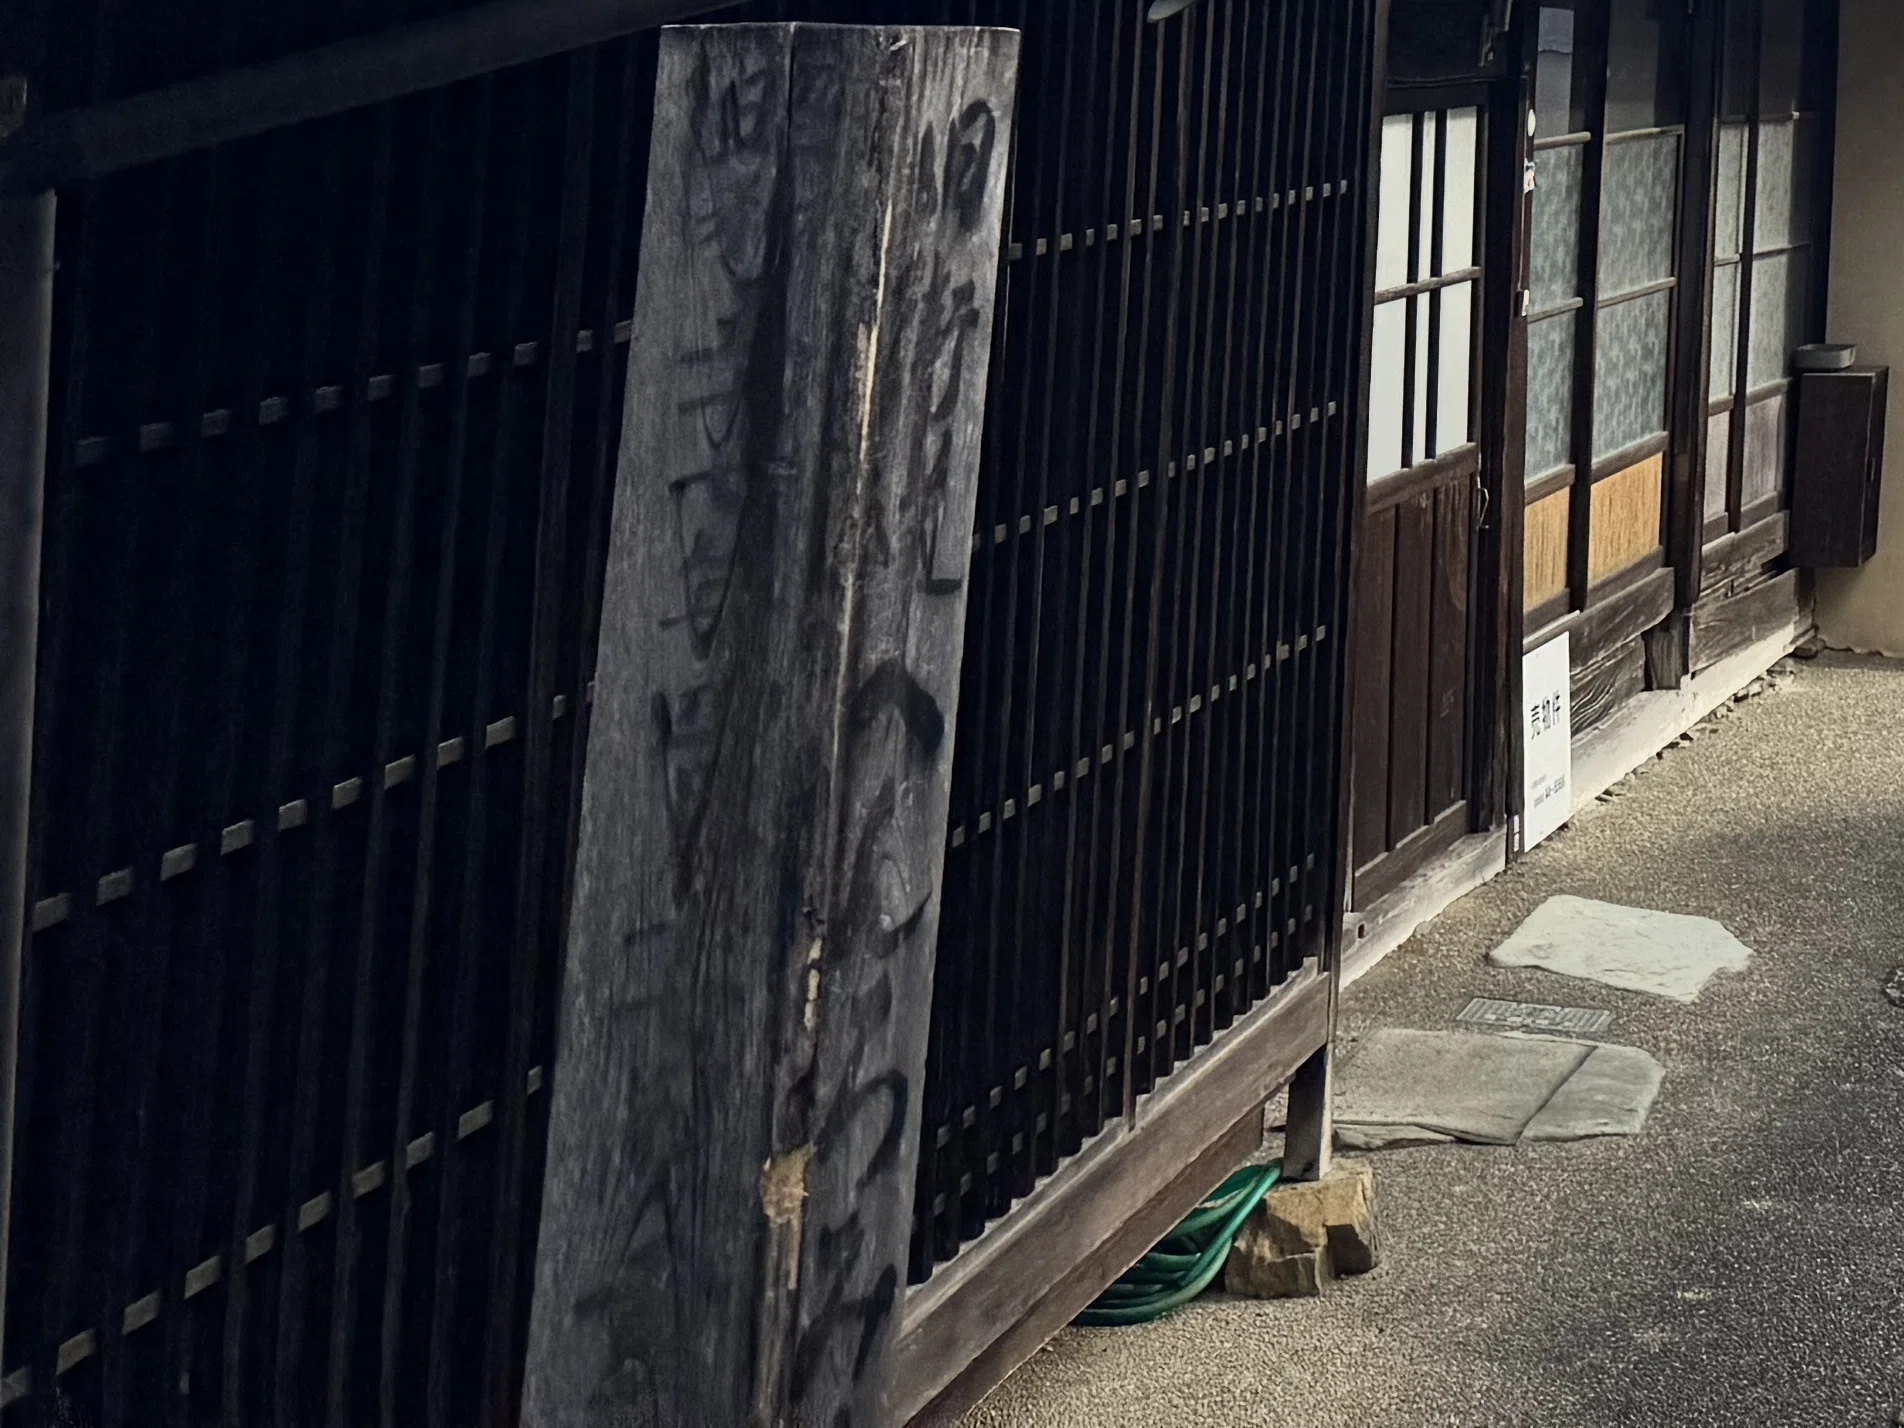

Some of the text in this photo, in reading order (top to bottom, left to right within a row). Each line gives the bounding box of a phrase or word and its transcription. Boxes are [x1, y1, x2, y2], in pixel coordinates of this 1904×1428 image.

[787, 97, 997, 1428] 旧街道へんろみ
[1529, 690, 1561, 741] 売物件
